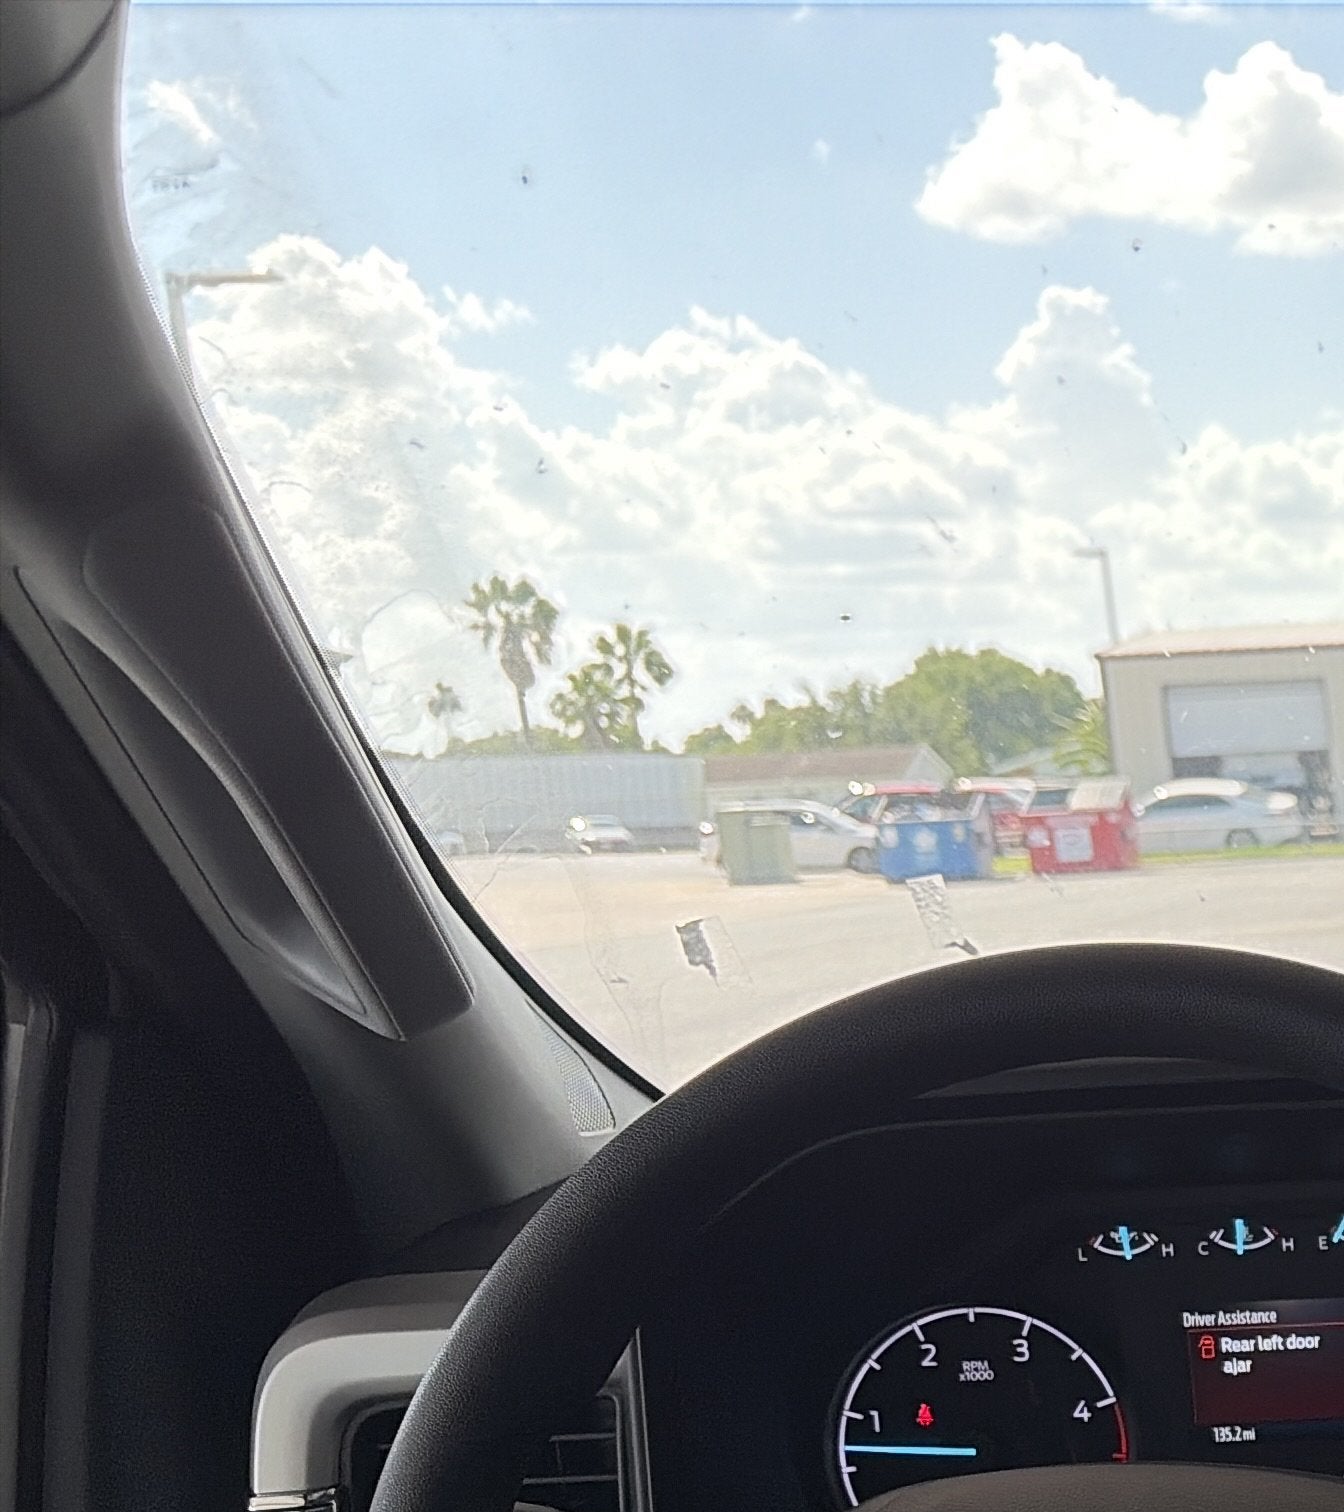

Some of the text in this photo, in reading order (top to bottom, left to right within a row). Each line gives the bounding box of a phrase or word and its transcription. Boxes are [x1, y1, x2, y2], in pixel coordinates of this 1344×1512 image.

[1161, 1243, 1174, 1257] H
[1198, 1241, 1209, 1255] C
[1281, 1237, 1294, 1252] H
[1318, 1236, 1328, 1250] E
[1078, 1248, 1089, 1262] L
[1182, 1309, 1278, 1328] Driver Assistance
[1012, 1338, 1030, 1362] 3
[1220, 1333, 1320, 1354] Rear left door
[920, 1343, 938, 1367] 2
[962, 1360, 990, 1371] RPM
[1222, 1357, 1252, 1376] ajar
[959, 1370, 995, 1382] x1000
[1072, 1400, 1092, 1422] 4
[869, 1410, 881, 1433] 1
